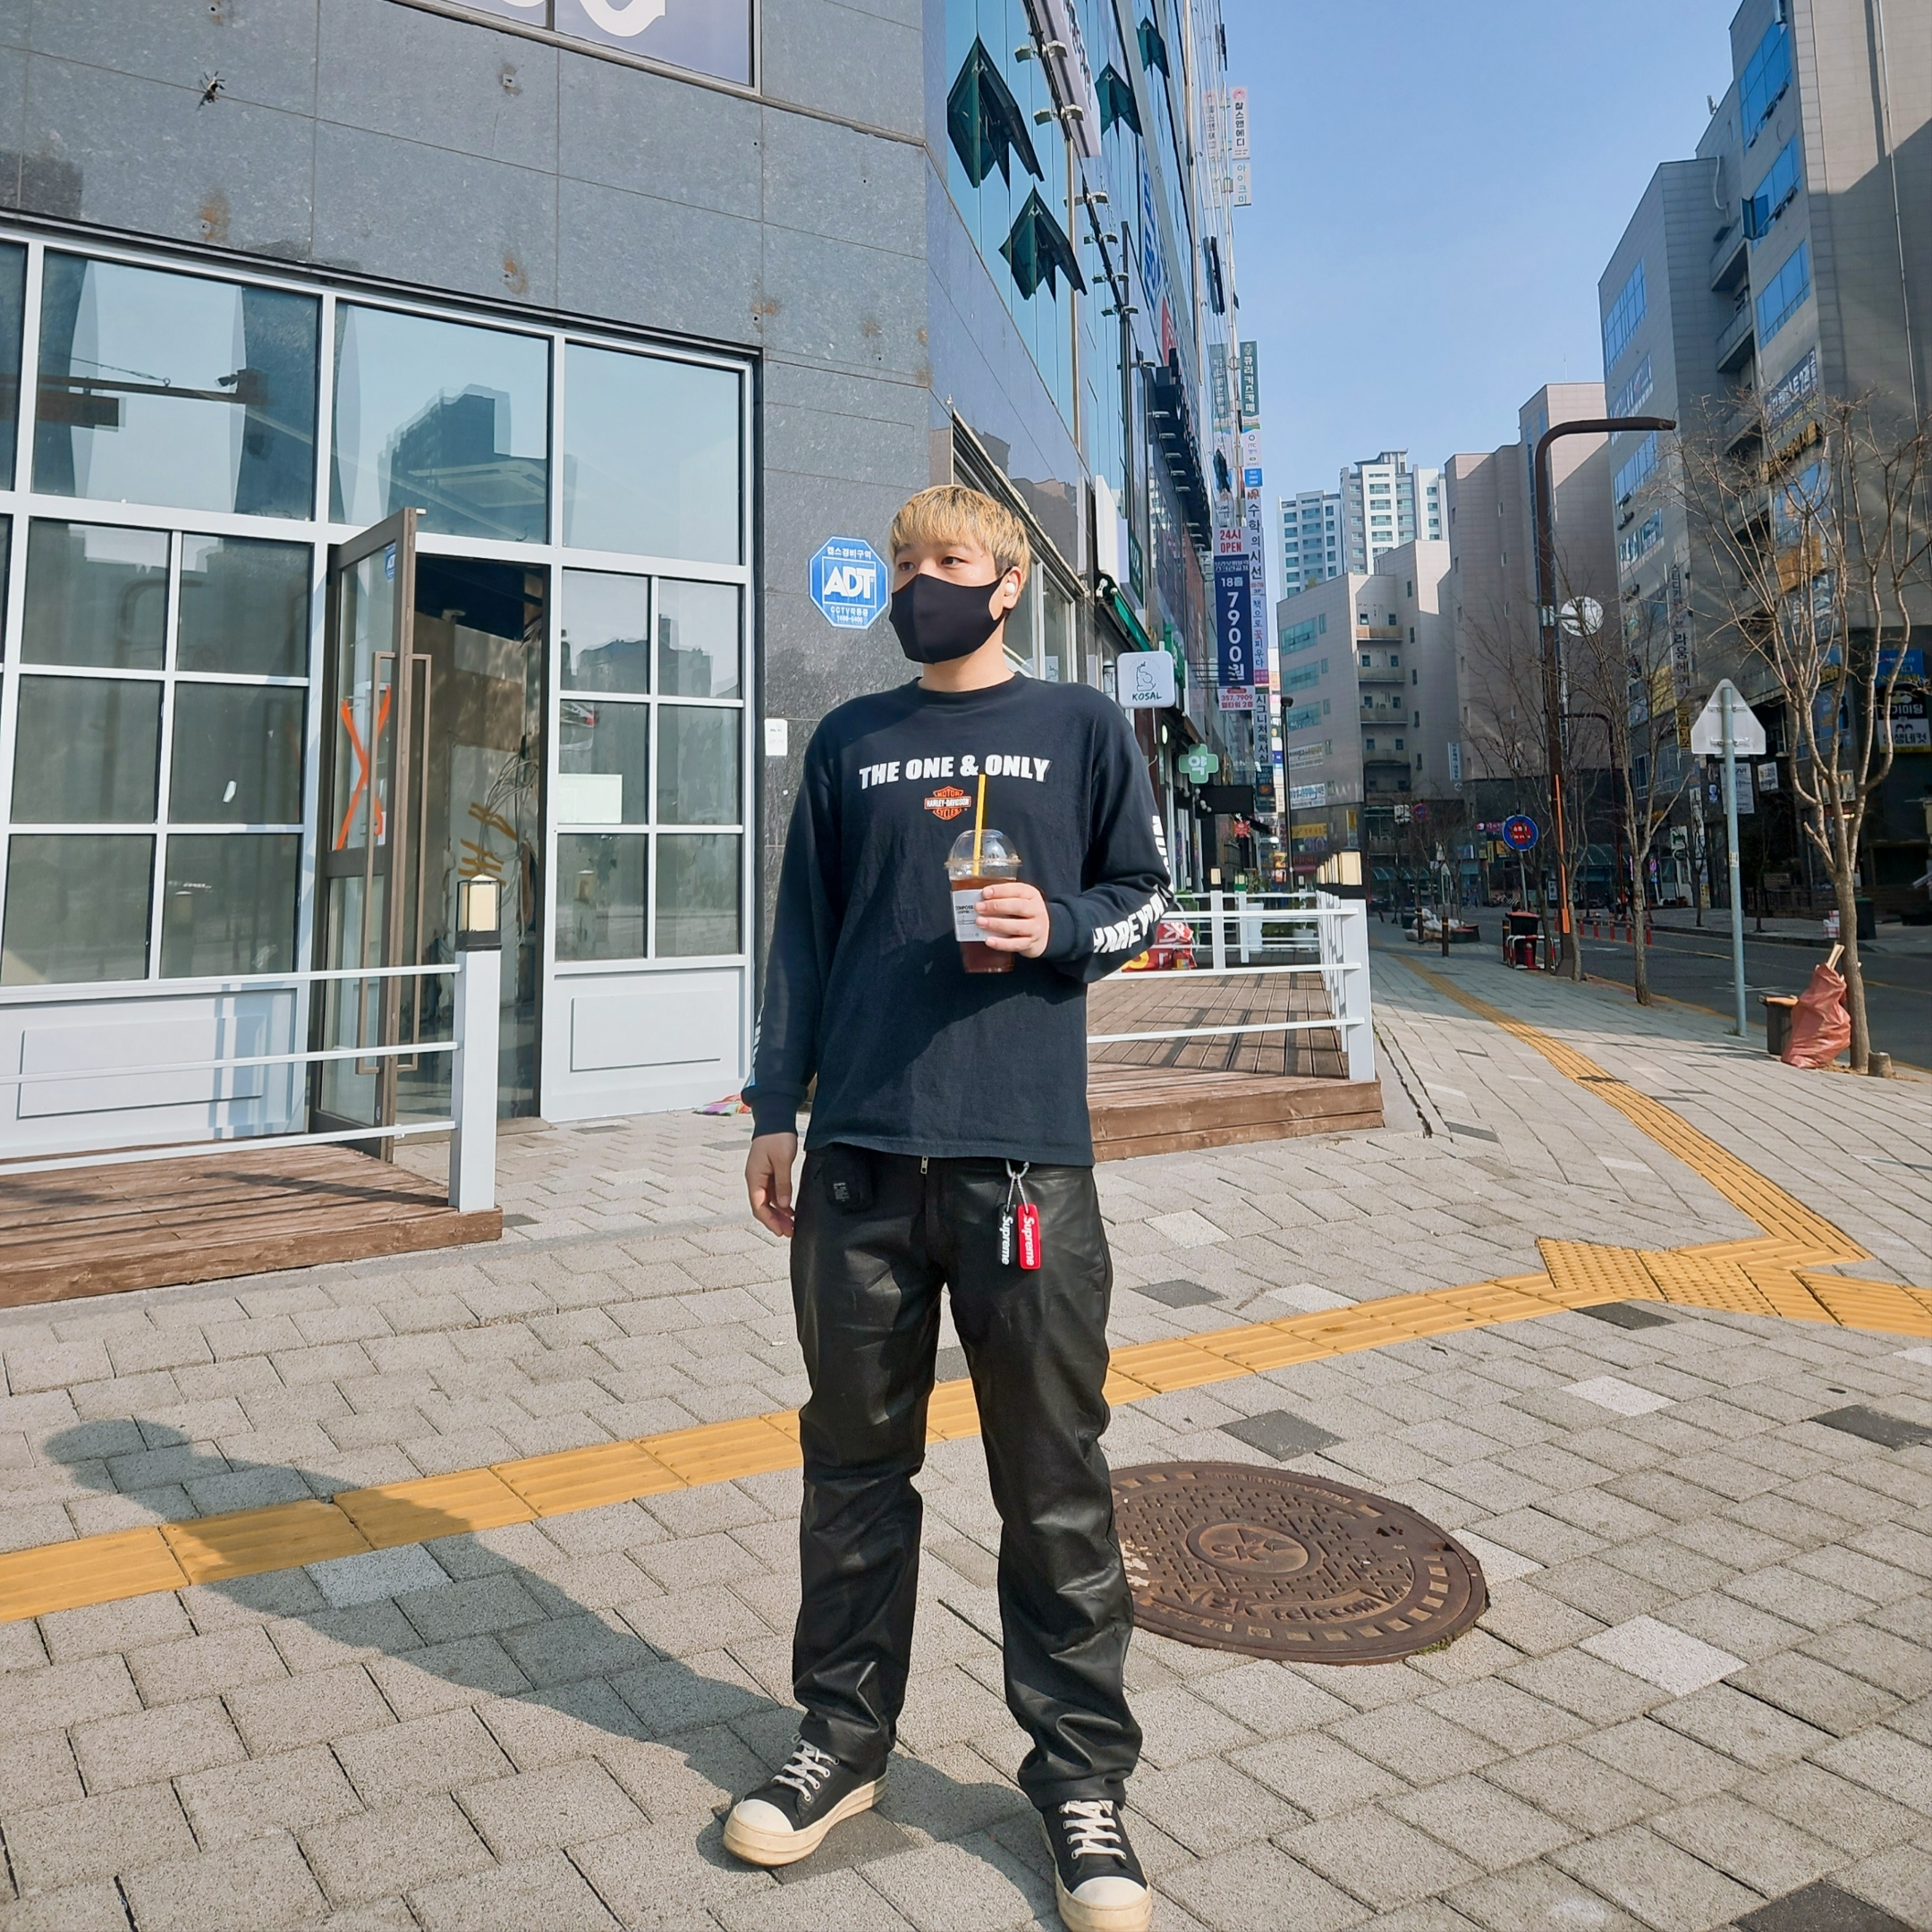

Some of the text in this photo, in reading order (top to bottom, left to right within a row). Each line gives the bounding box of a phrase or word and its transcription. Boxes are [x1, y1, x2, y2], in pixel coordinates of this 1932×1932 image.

[1219, 529, 1241, 540] 24시
[1220, 541, 1242, 554] OPEN
[823, 565, 876, 599] ADT
[1131, 691, 1163, 701] KOSAL
[859, 754, 1051, 791] THE ONE & ONLY
[1188, 755, 1208, 775] 약
[926, 798, 970, 808] HARLEY-DAVIDSON
[936, 789, 961, 798] MOTOR
[936, 808, 960, 818] CYCLES
[999, 1215, 1013, 1266] Supreme
[1021, 1216, 1035, 1267] Supreme
[1210, 1542, 1261, 1562] SK
[1273, 1597, 1383, 1621] telecom
